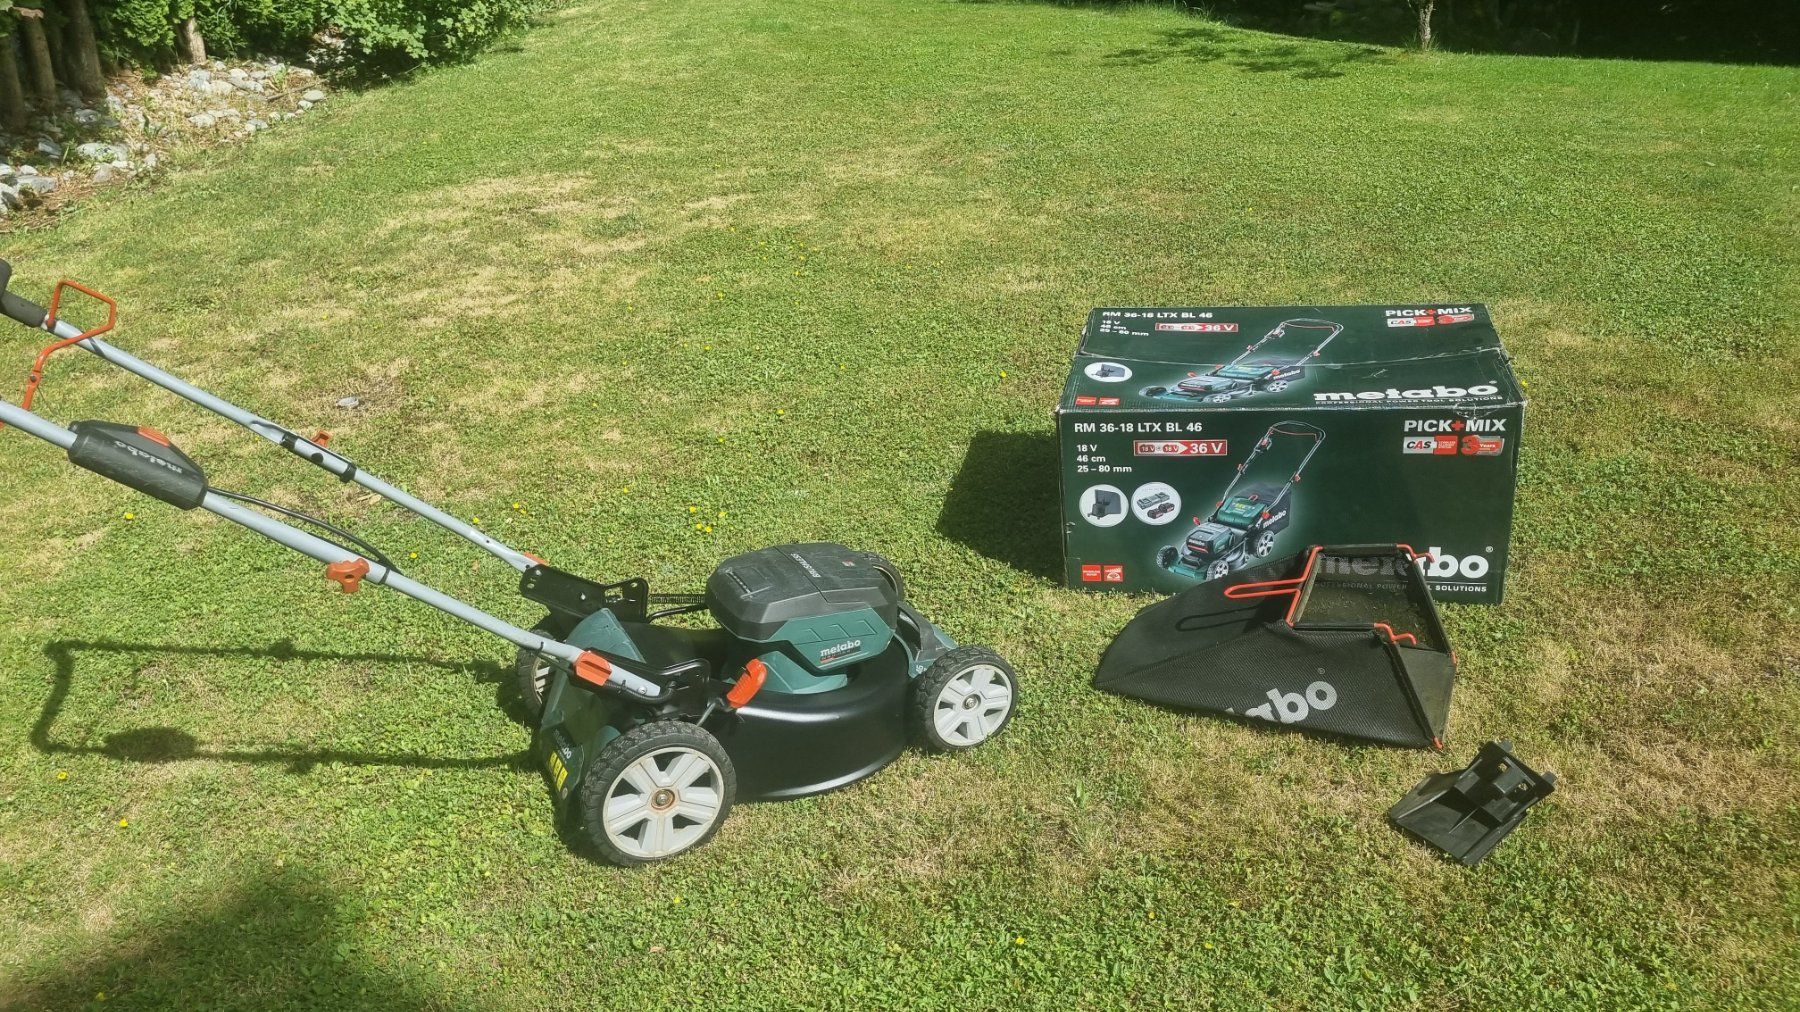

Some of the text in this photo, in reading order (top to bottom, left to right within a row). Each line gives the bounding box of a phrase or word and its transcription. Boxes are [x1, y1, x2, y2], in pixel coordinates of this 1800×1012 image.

[1313, 385, 1498, 400] metabo
[1074, 422, 1203, 432] RM 36-18 LTX BL 46
[1076, 444, 1097, 452] 18 V
[1190, 443, 1224, 454] 36 V
[1407, 441, 1431, 449] CAS
[114, 440, 182, 474] metabo
[820, 639, 861, 657] metabo
